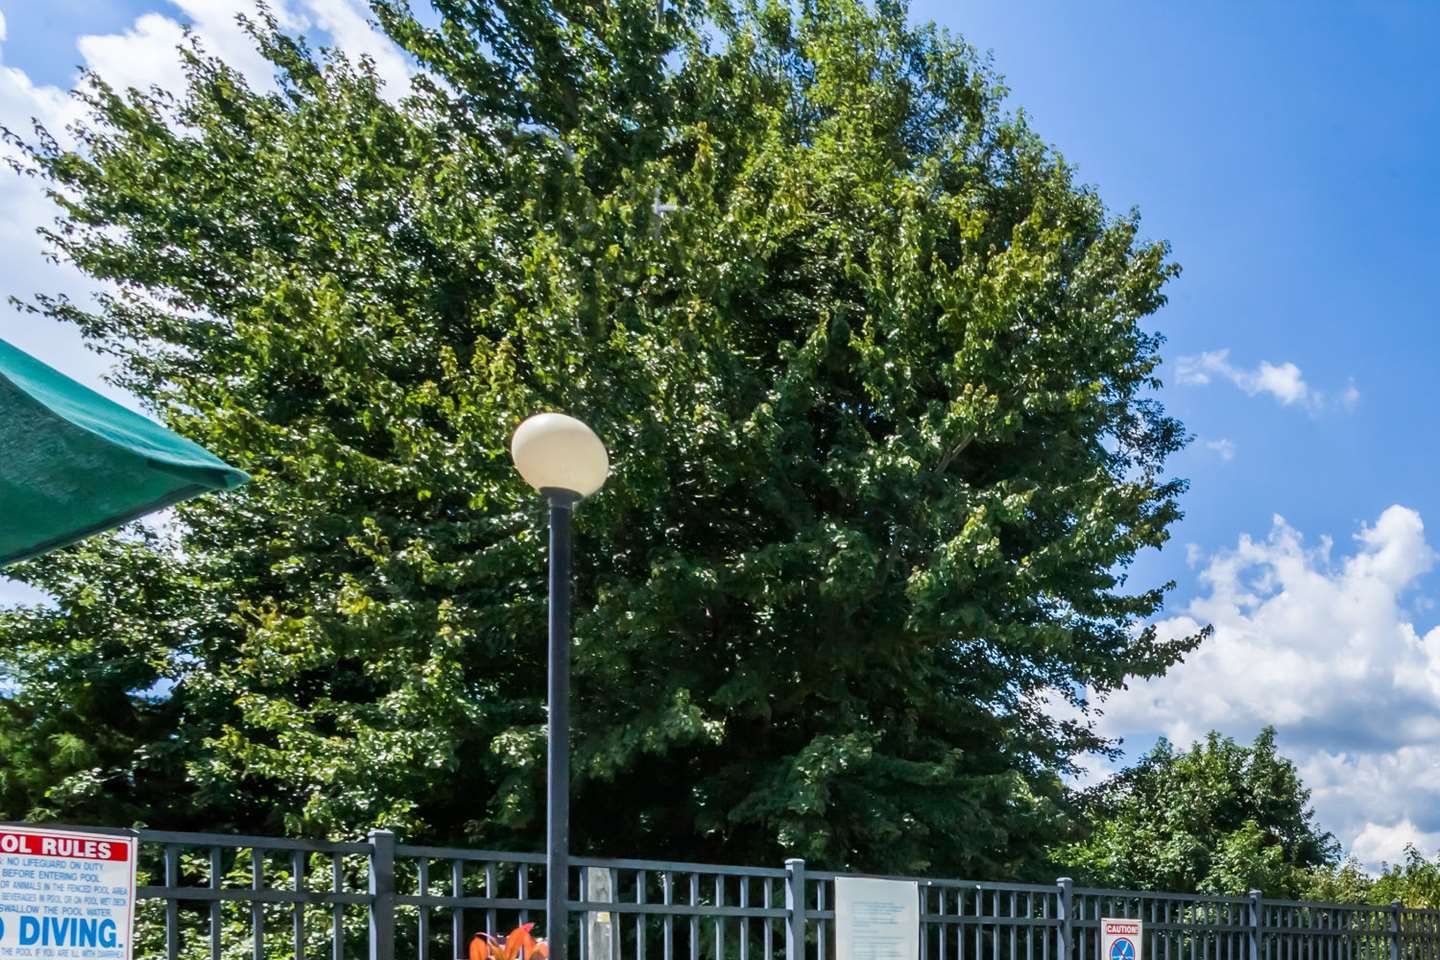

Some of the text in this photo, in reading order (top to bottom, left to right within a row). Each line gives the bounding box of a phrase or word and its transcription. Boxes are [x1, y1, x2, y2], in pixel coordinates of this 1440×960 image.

[41, 837, 112, 859] RULES
[23, 857, 67, 869] LIFEGUARD
[2, 868, 35, 879] BEFORE
[38, 871, 77, 881] ENTERING
[13, 881, 41, 891] ANIMALS
[0, 903, 39, 913] SWALLOW
[19, 915, 123, 948] DIVING.
